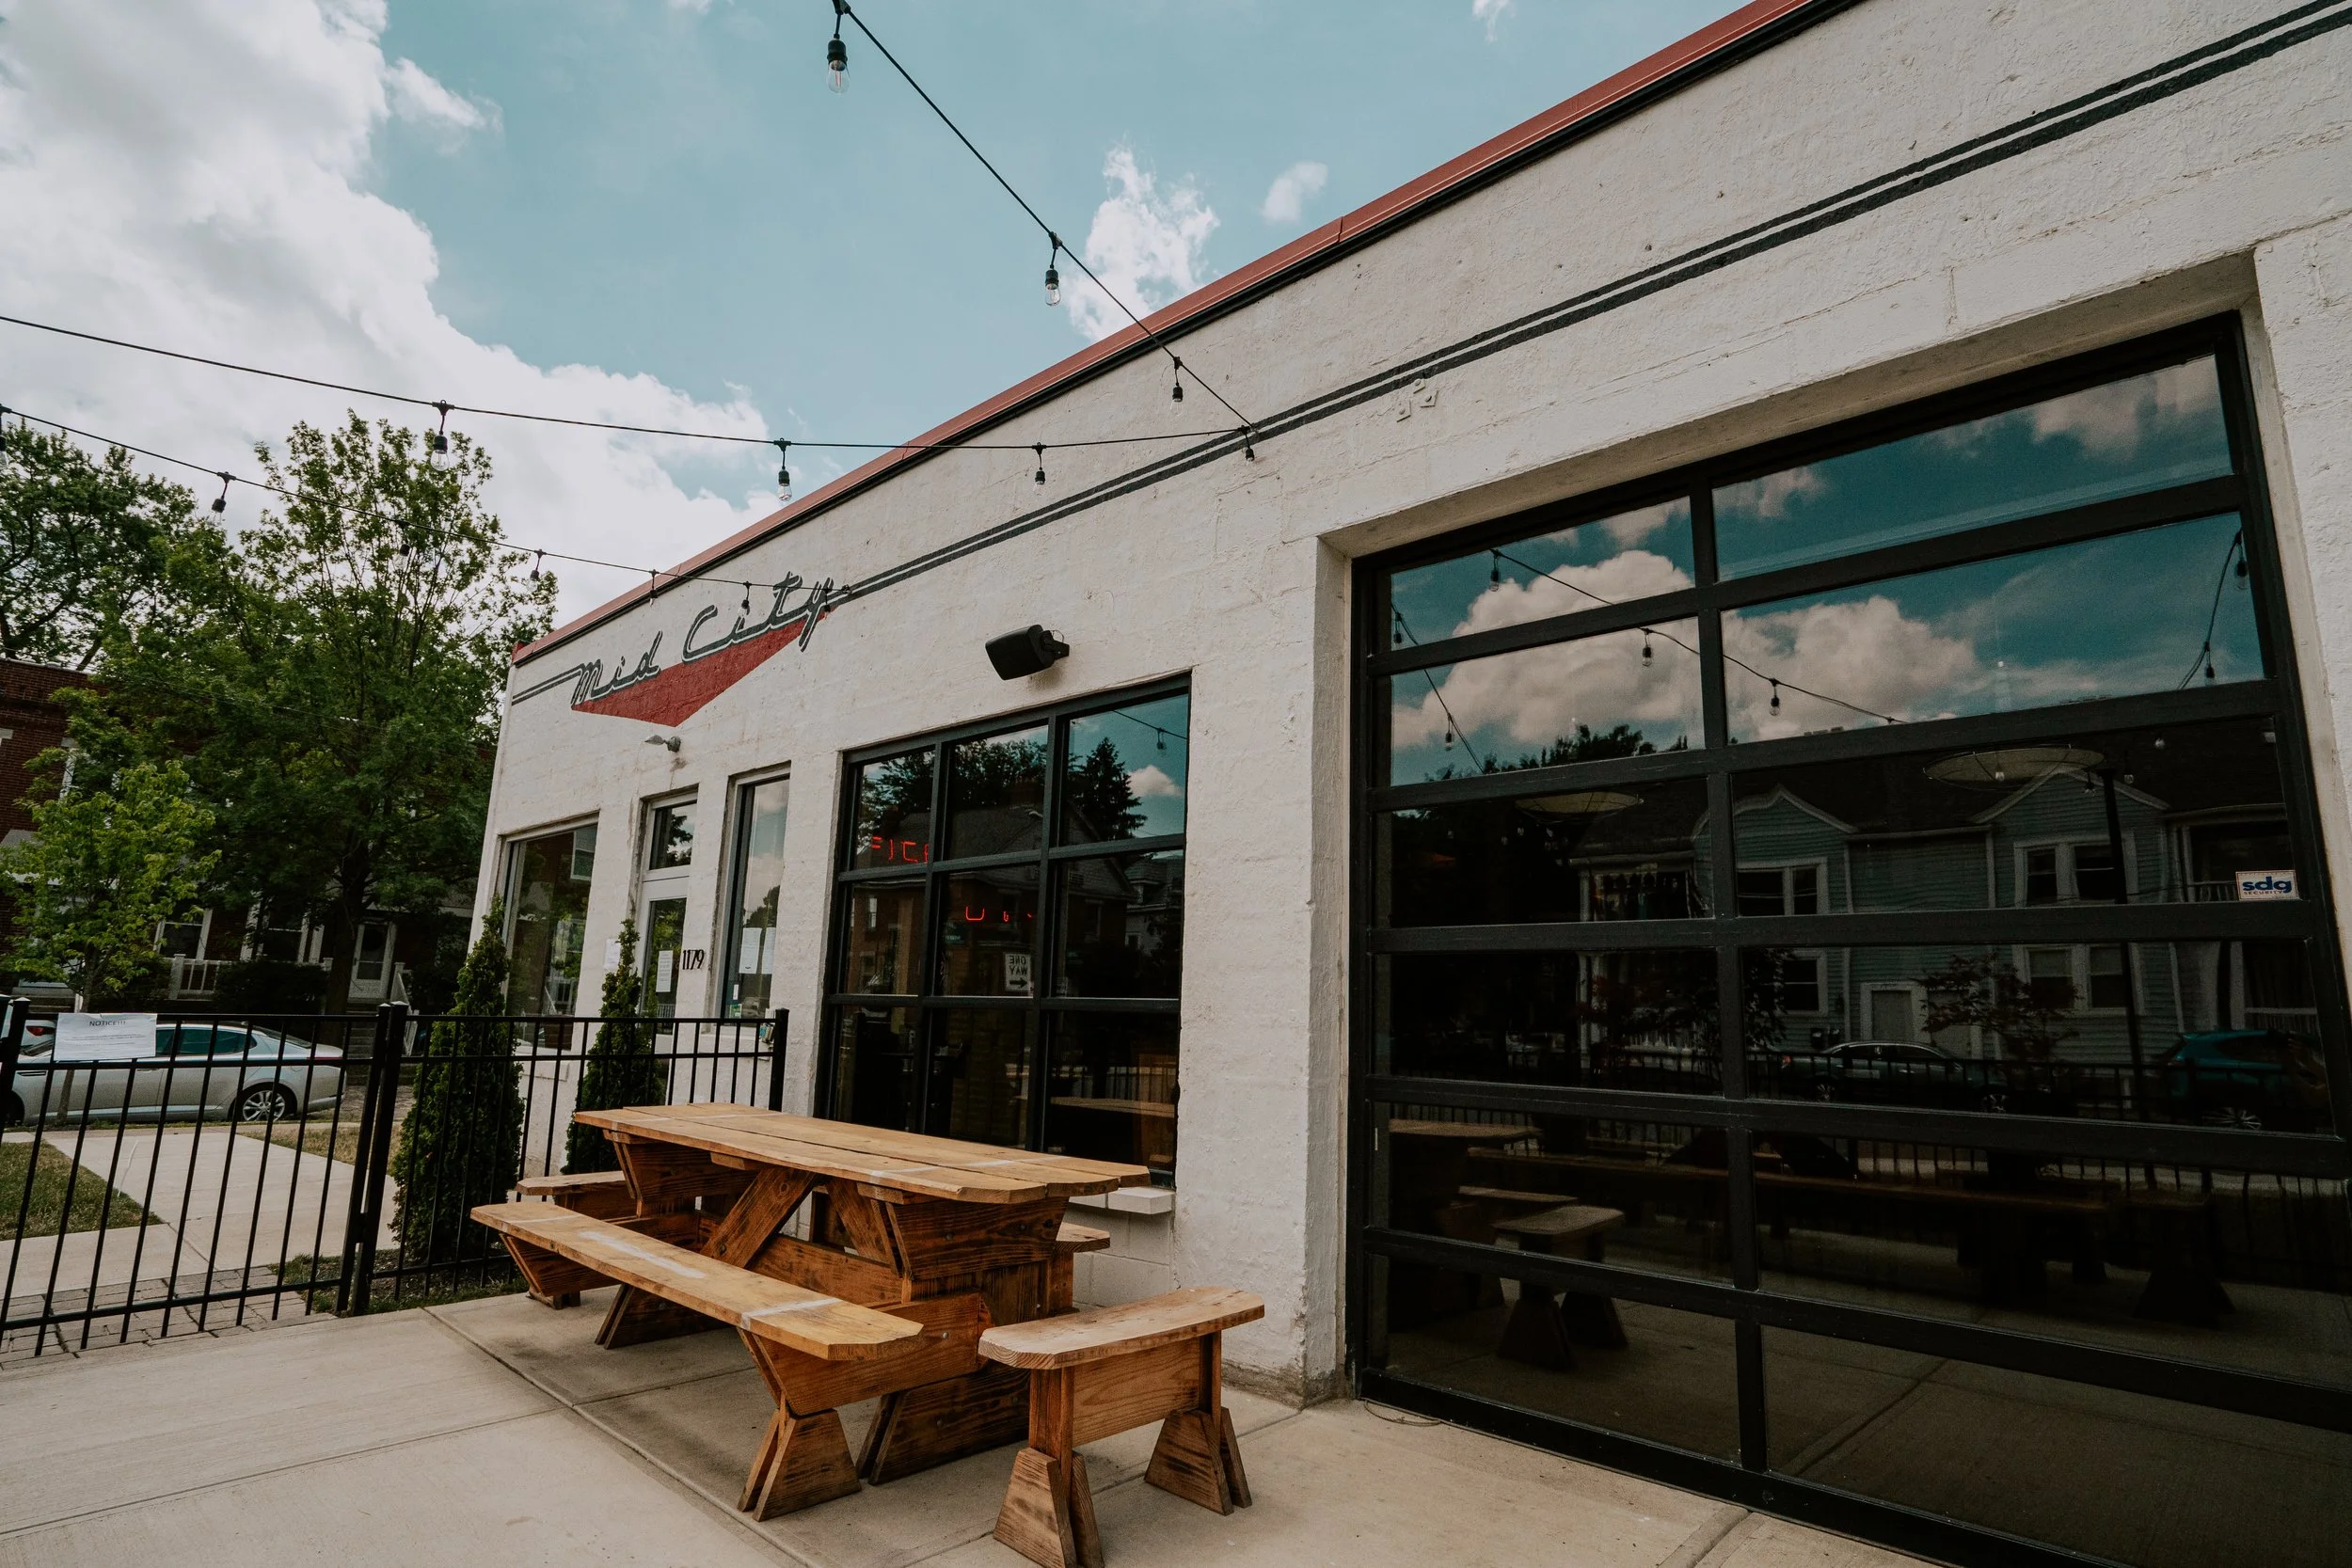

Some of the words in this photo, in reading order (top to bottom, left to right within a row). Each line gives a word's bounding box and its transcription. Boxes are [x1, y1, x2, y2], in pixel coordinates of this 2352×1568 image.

[570, 630, 662, 705] Mid
[682, 571, 839, 662] City
[2242, 876, 2293, 894] sdg
[682, 949, 705, 970] 1179
